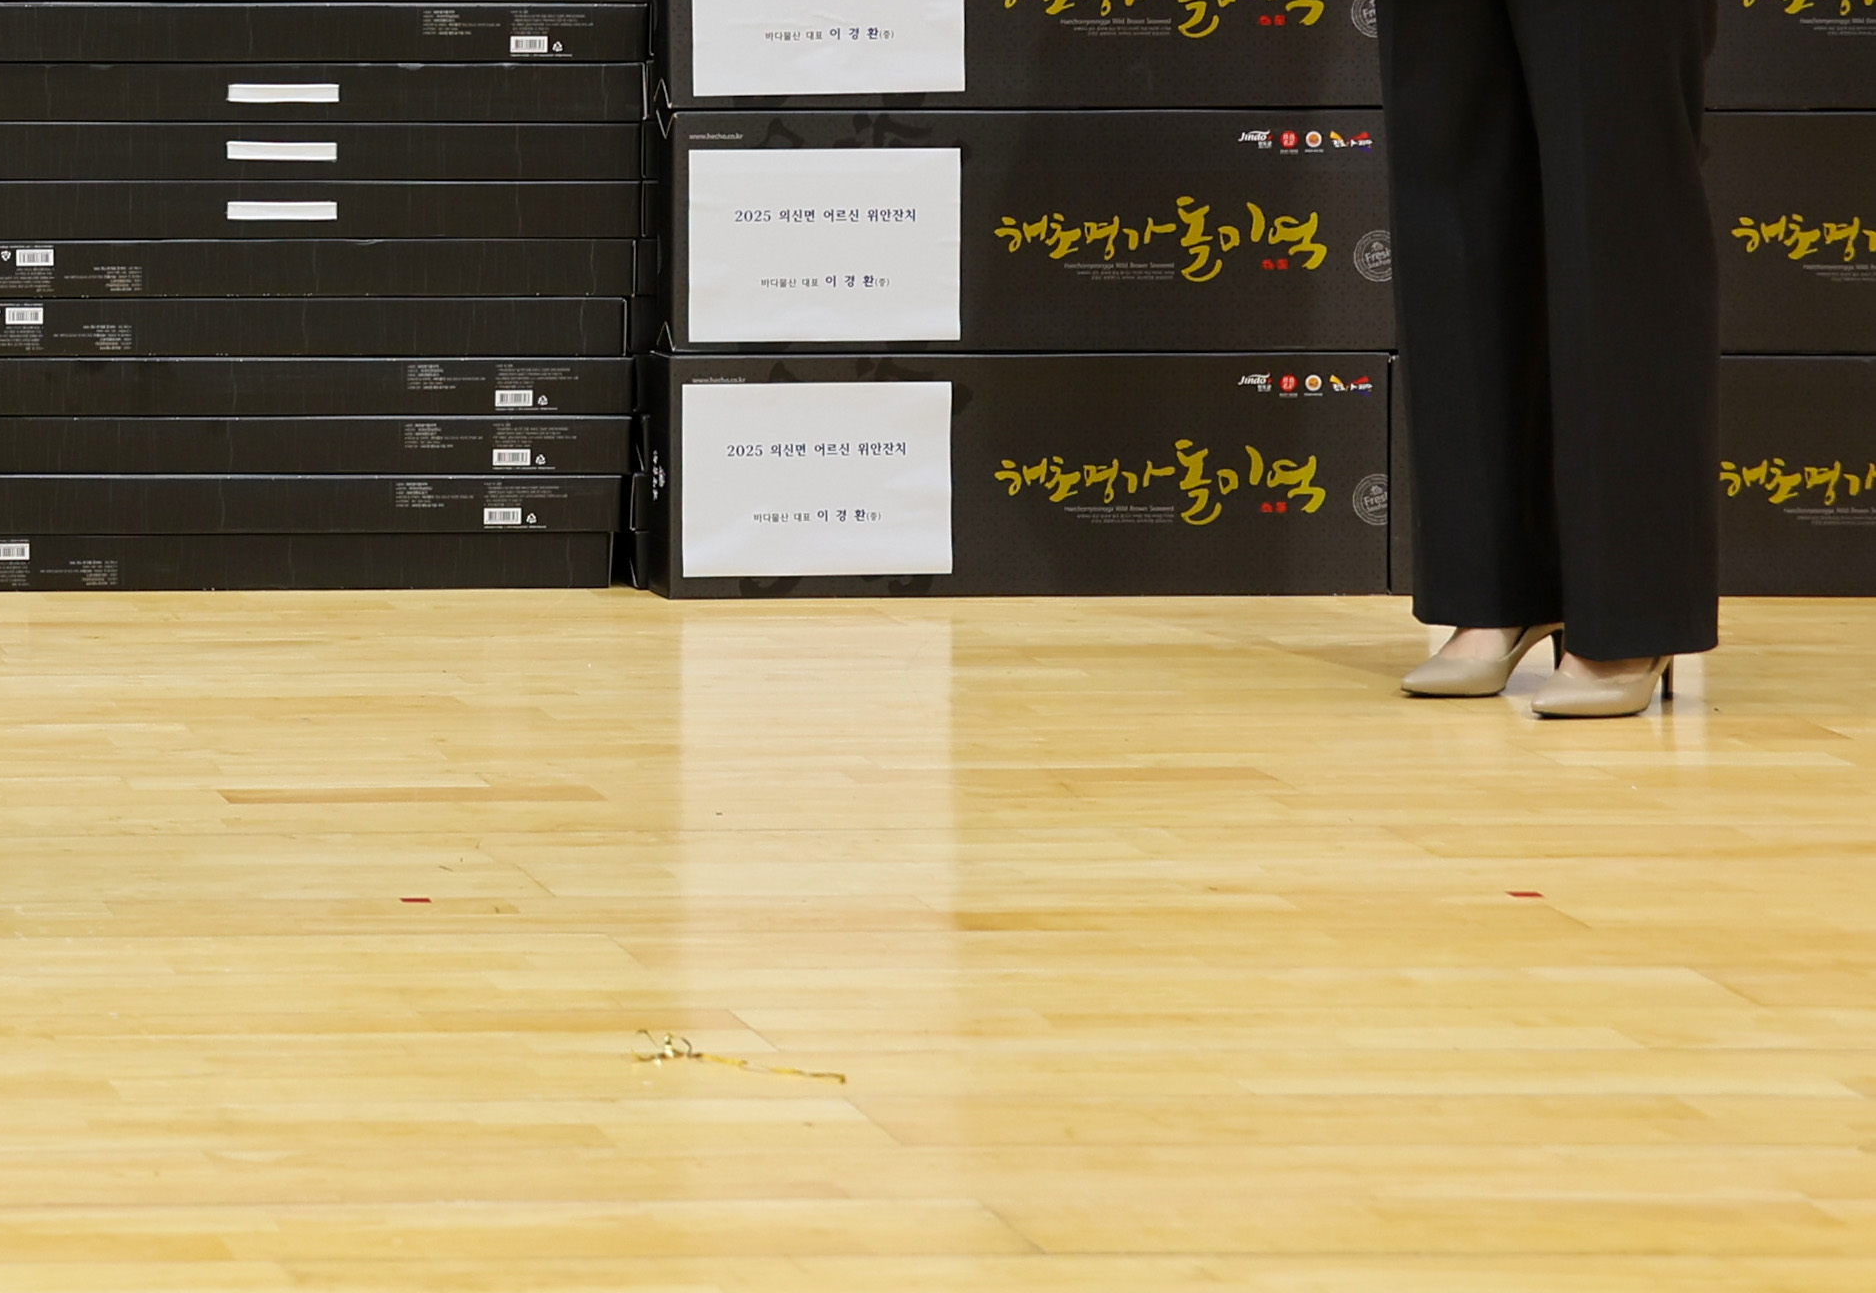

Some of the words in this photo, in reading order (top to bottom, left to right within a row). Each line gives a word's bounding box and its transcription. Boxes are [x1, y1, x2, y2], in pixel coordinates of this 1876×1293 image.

[764, 30, 801, 42] 바다물산
[734, 209, 772, 223] 2025
[778, 208, 816, 224] 의신면
[822, 208, 860, 224] 어르신
[866, 208, 916, 223] 위안잔치
[994, 212, 1177, 261] 해초명가
[1176, 196, 1328, 283] 돌미역
[1731, 213, 1876, 262] 해초명
[726, 444, 764, 458] 2025
[769, 442, 807, 458] 의신면
[813, 442, 850, 458] 어르신
[857, 441, 907, 457] 위안잔치
[994, 455, 1176, 503] 해초명가
[1174, 438, 1327, 526] 돌미역
